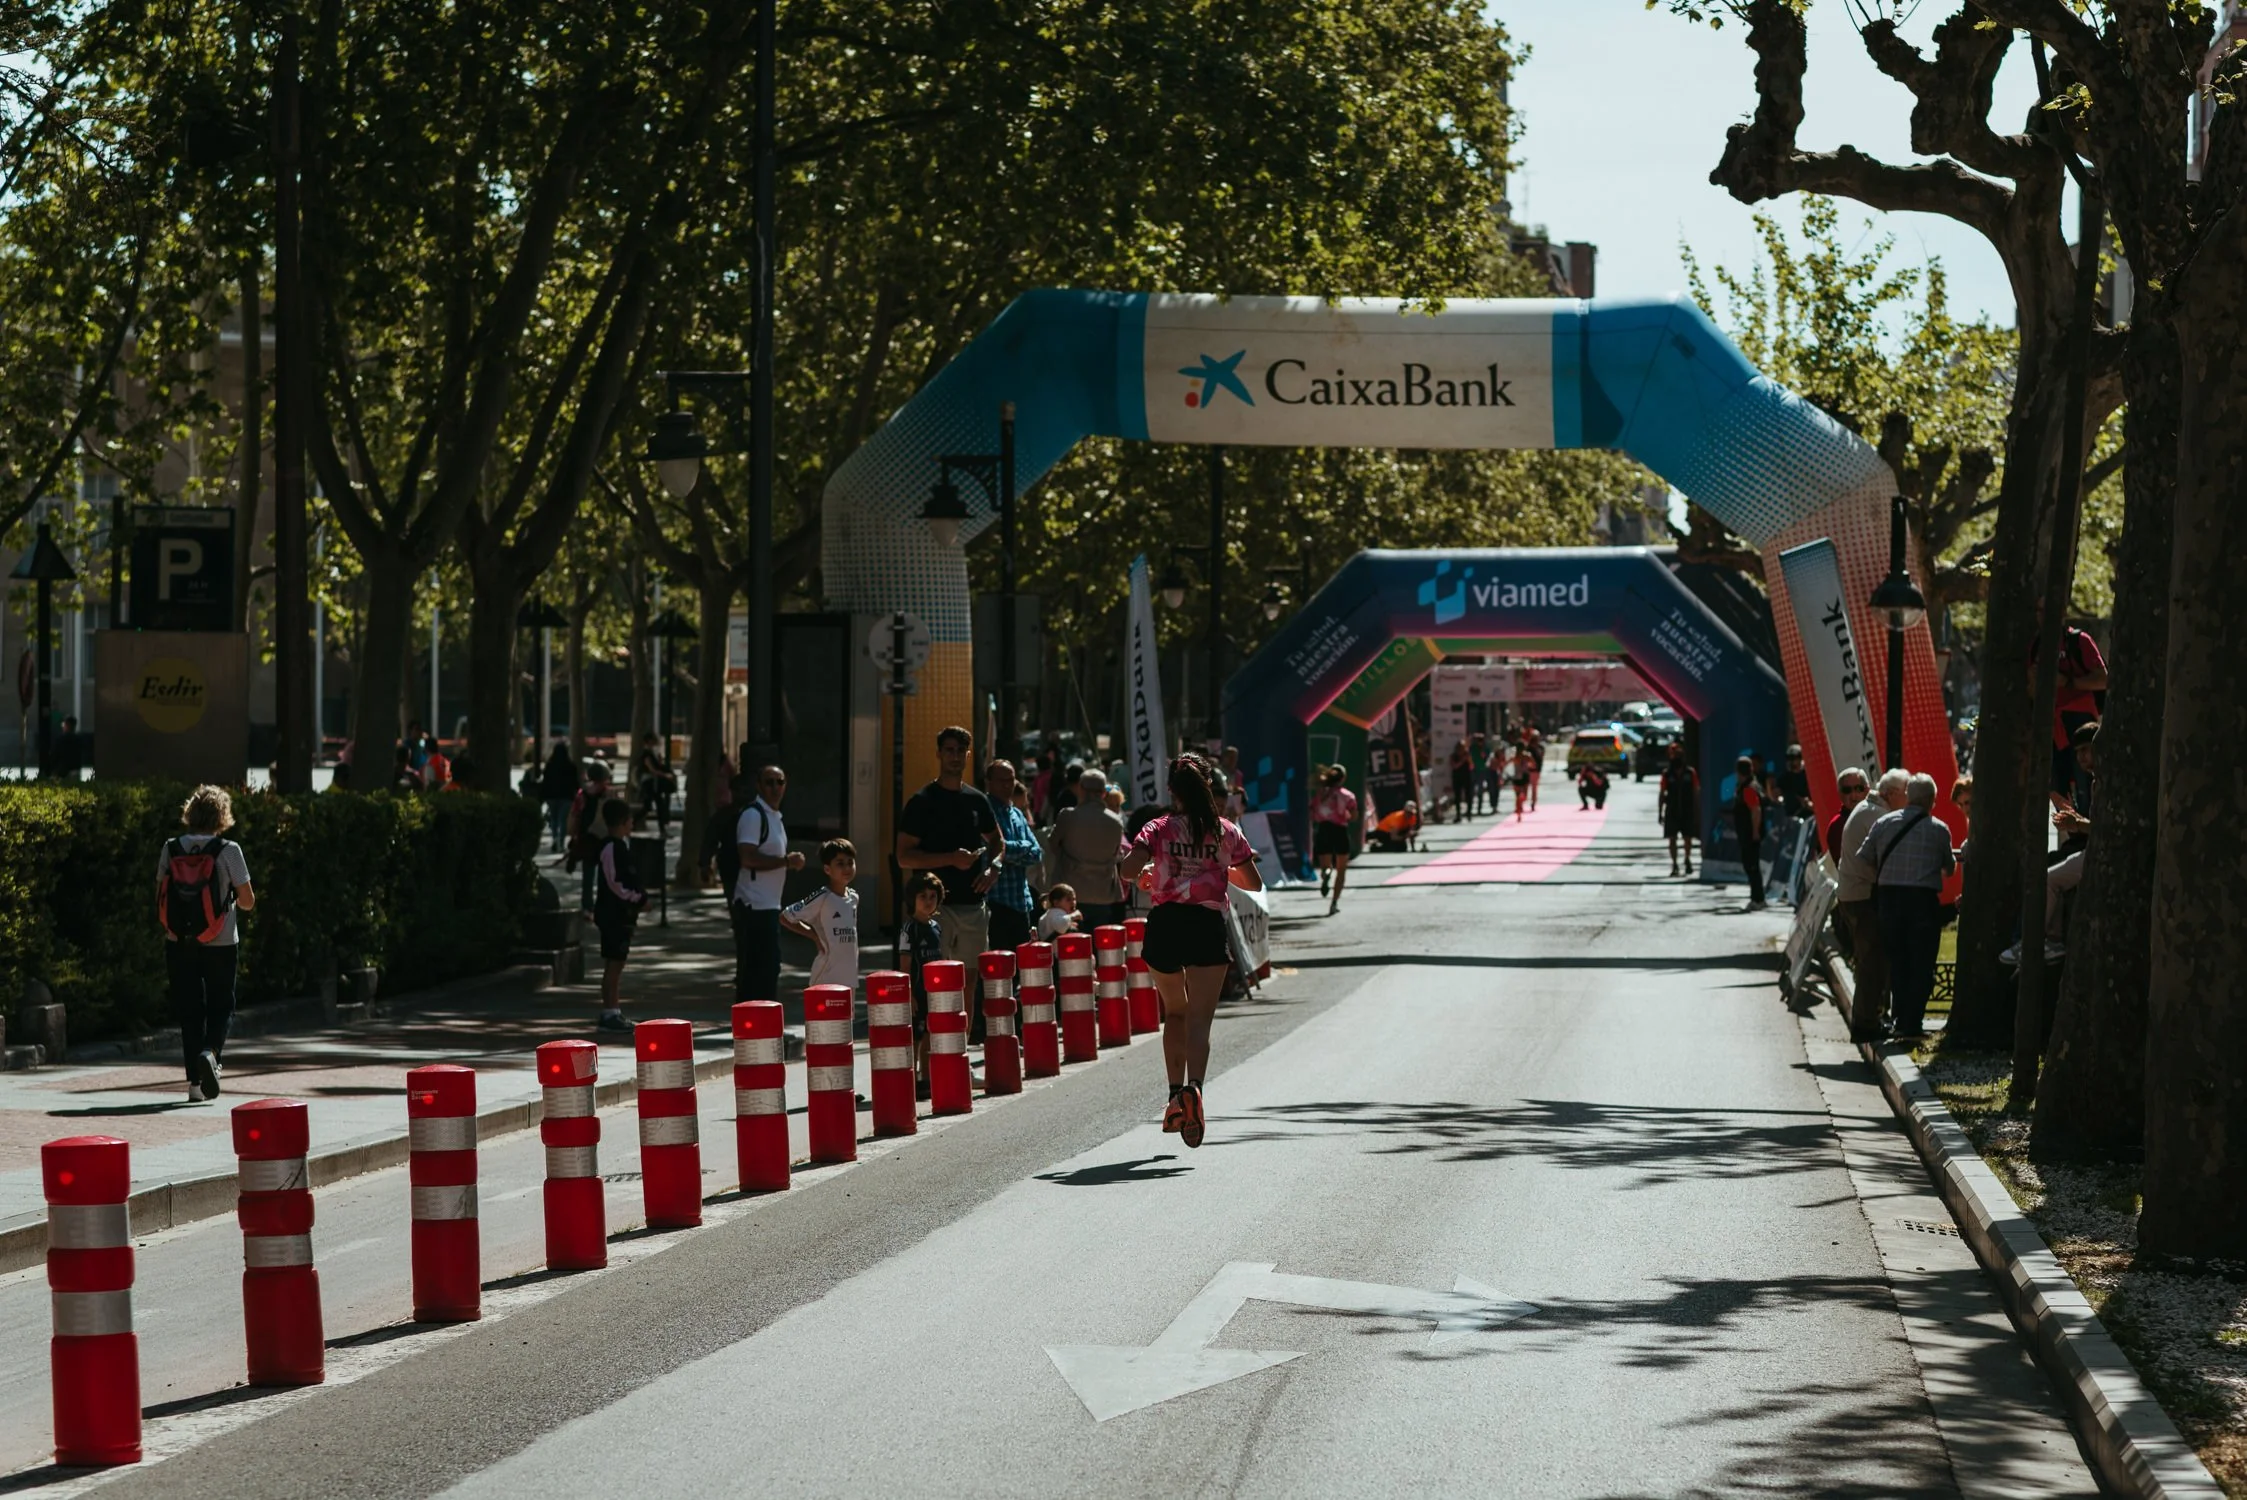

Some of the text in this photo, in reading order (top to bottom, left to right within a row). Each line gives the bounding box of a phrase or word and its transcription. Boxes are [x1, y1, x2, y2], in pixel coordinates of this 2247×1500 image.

[1265, 358, 1515, 407] CaixaBank
[159, 537, 204, 600] P
[1472, 573, 1589, 608] viamed
[1296, 624, 1349, 677] nuestra
[1660, 619, 1713, 671] nuestra
[140, 676, 203, 699] Esdir
